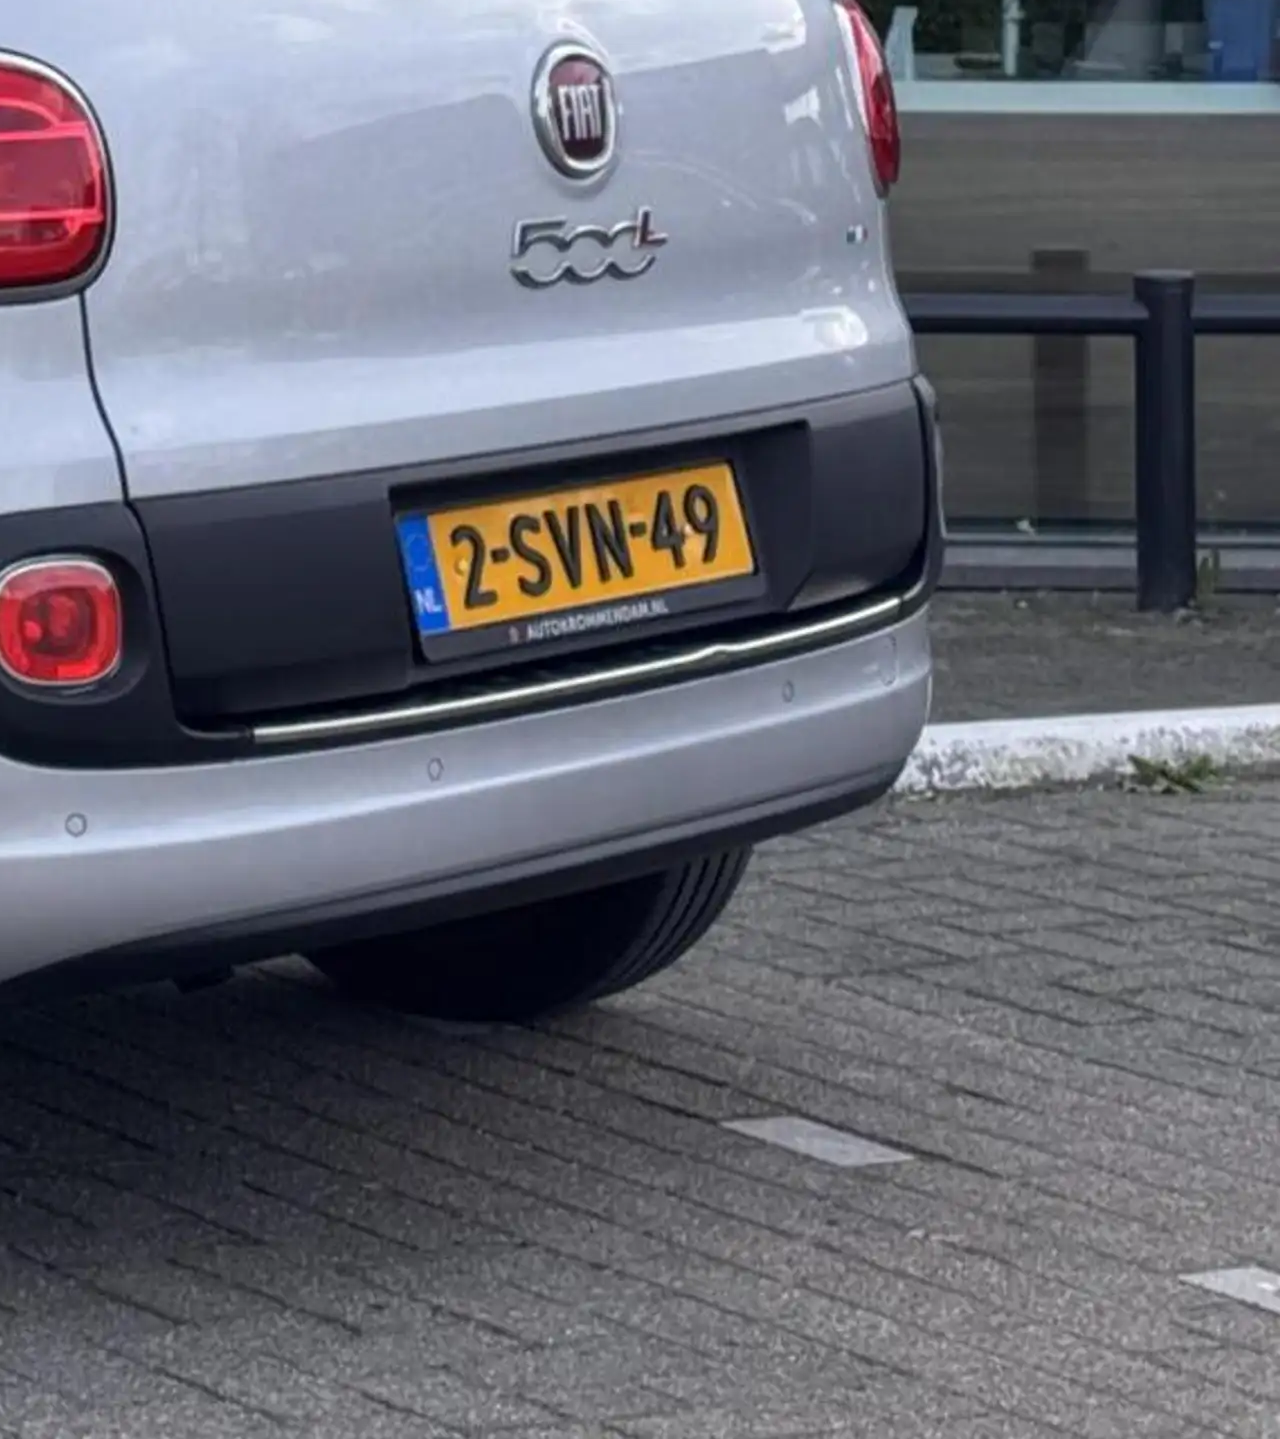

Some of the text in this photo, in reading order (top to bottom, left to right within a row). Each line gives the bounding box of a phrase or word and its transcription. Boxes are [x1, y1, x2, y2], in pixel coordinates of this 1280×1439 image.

[557, 84, 602, 141] FIAT
[510, 205, 670, 290] 500L
[449, 483, 722, 610] 2-SVN-49
[413, 585, 443, 615] NL
